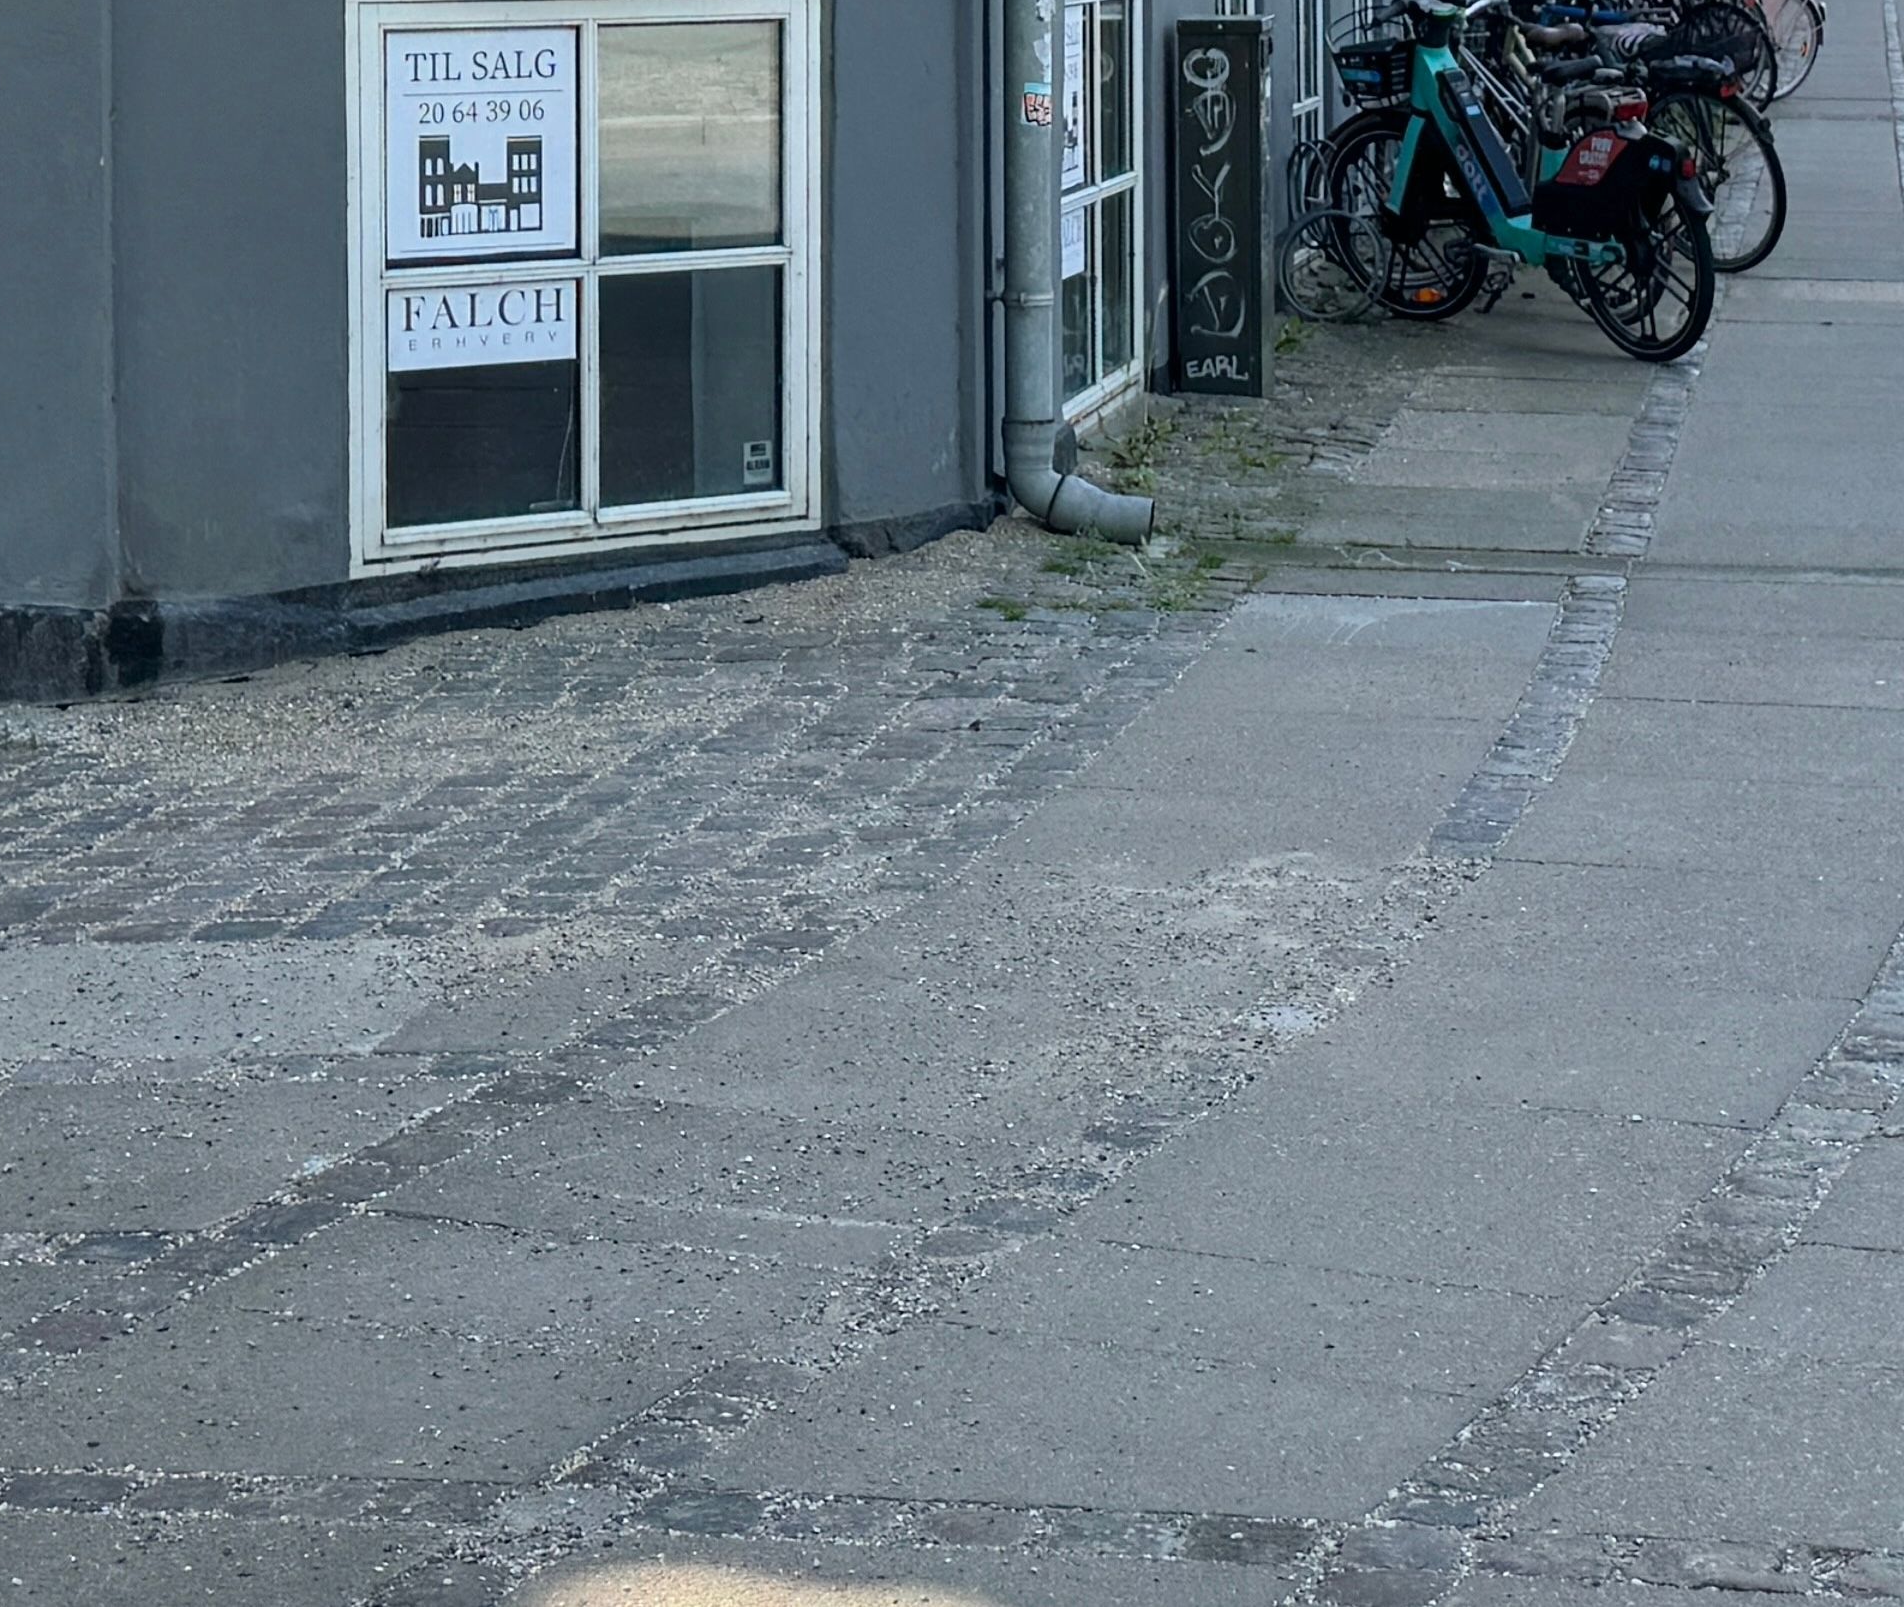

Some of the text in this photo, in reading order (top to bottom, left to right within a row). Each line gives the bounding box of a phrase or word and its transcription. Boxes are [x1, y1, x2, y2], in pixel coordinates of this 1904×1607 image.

[404, 48, 557, 82] TIL SALG
[418, 98, 545, 124] 20 64 39 06
[401, 287, 565, 332] FALCH
[408, 331, 557, 352] ERHVERV
[1186, 354, 1249, 381] EARL
